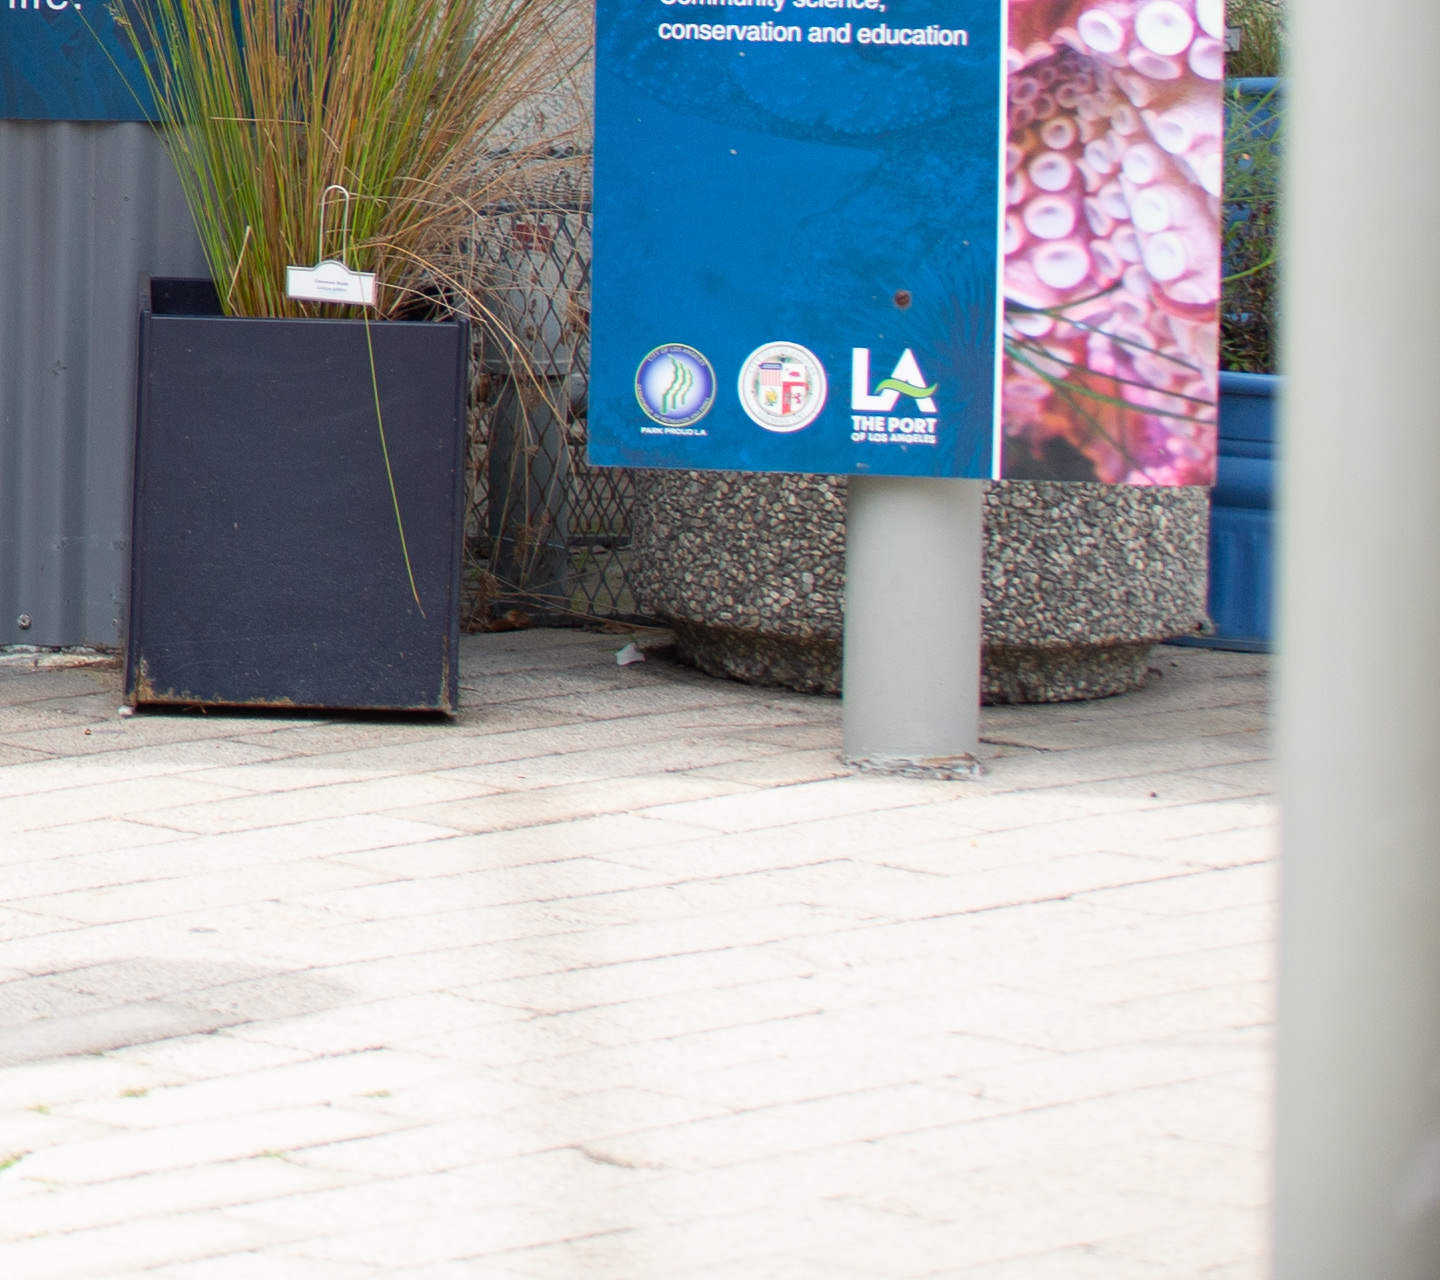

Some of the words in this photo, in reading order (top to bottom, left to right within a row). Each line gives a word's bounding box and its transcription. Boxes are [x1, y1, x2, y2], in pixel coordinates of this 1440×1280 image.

[658, 21, 801, 41] conservation
[808, 23, 850, 43] and
[857, 24, 967, 45] education
[852, 347, 937, 412] LA
[664, 427, 693, 435] PROUD
[851, 416, 885, 432] THE
[888, 417, 937, 433] PORT
[851, 432, 866, 442] OF
[869, 433, 888, 443] LOS
[890, 434, 937, 444] ANGELES
